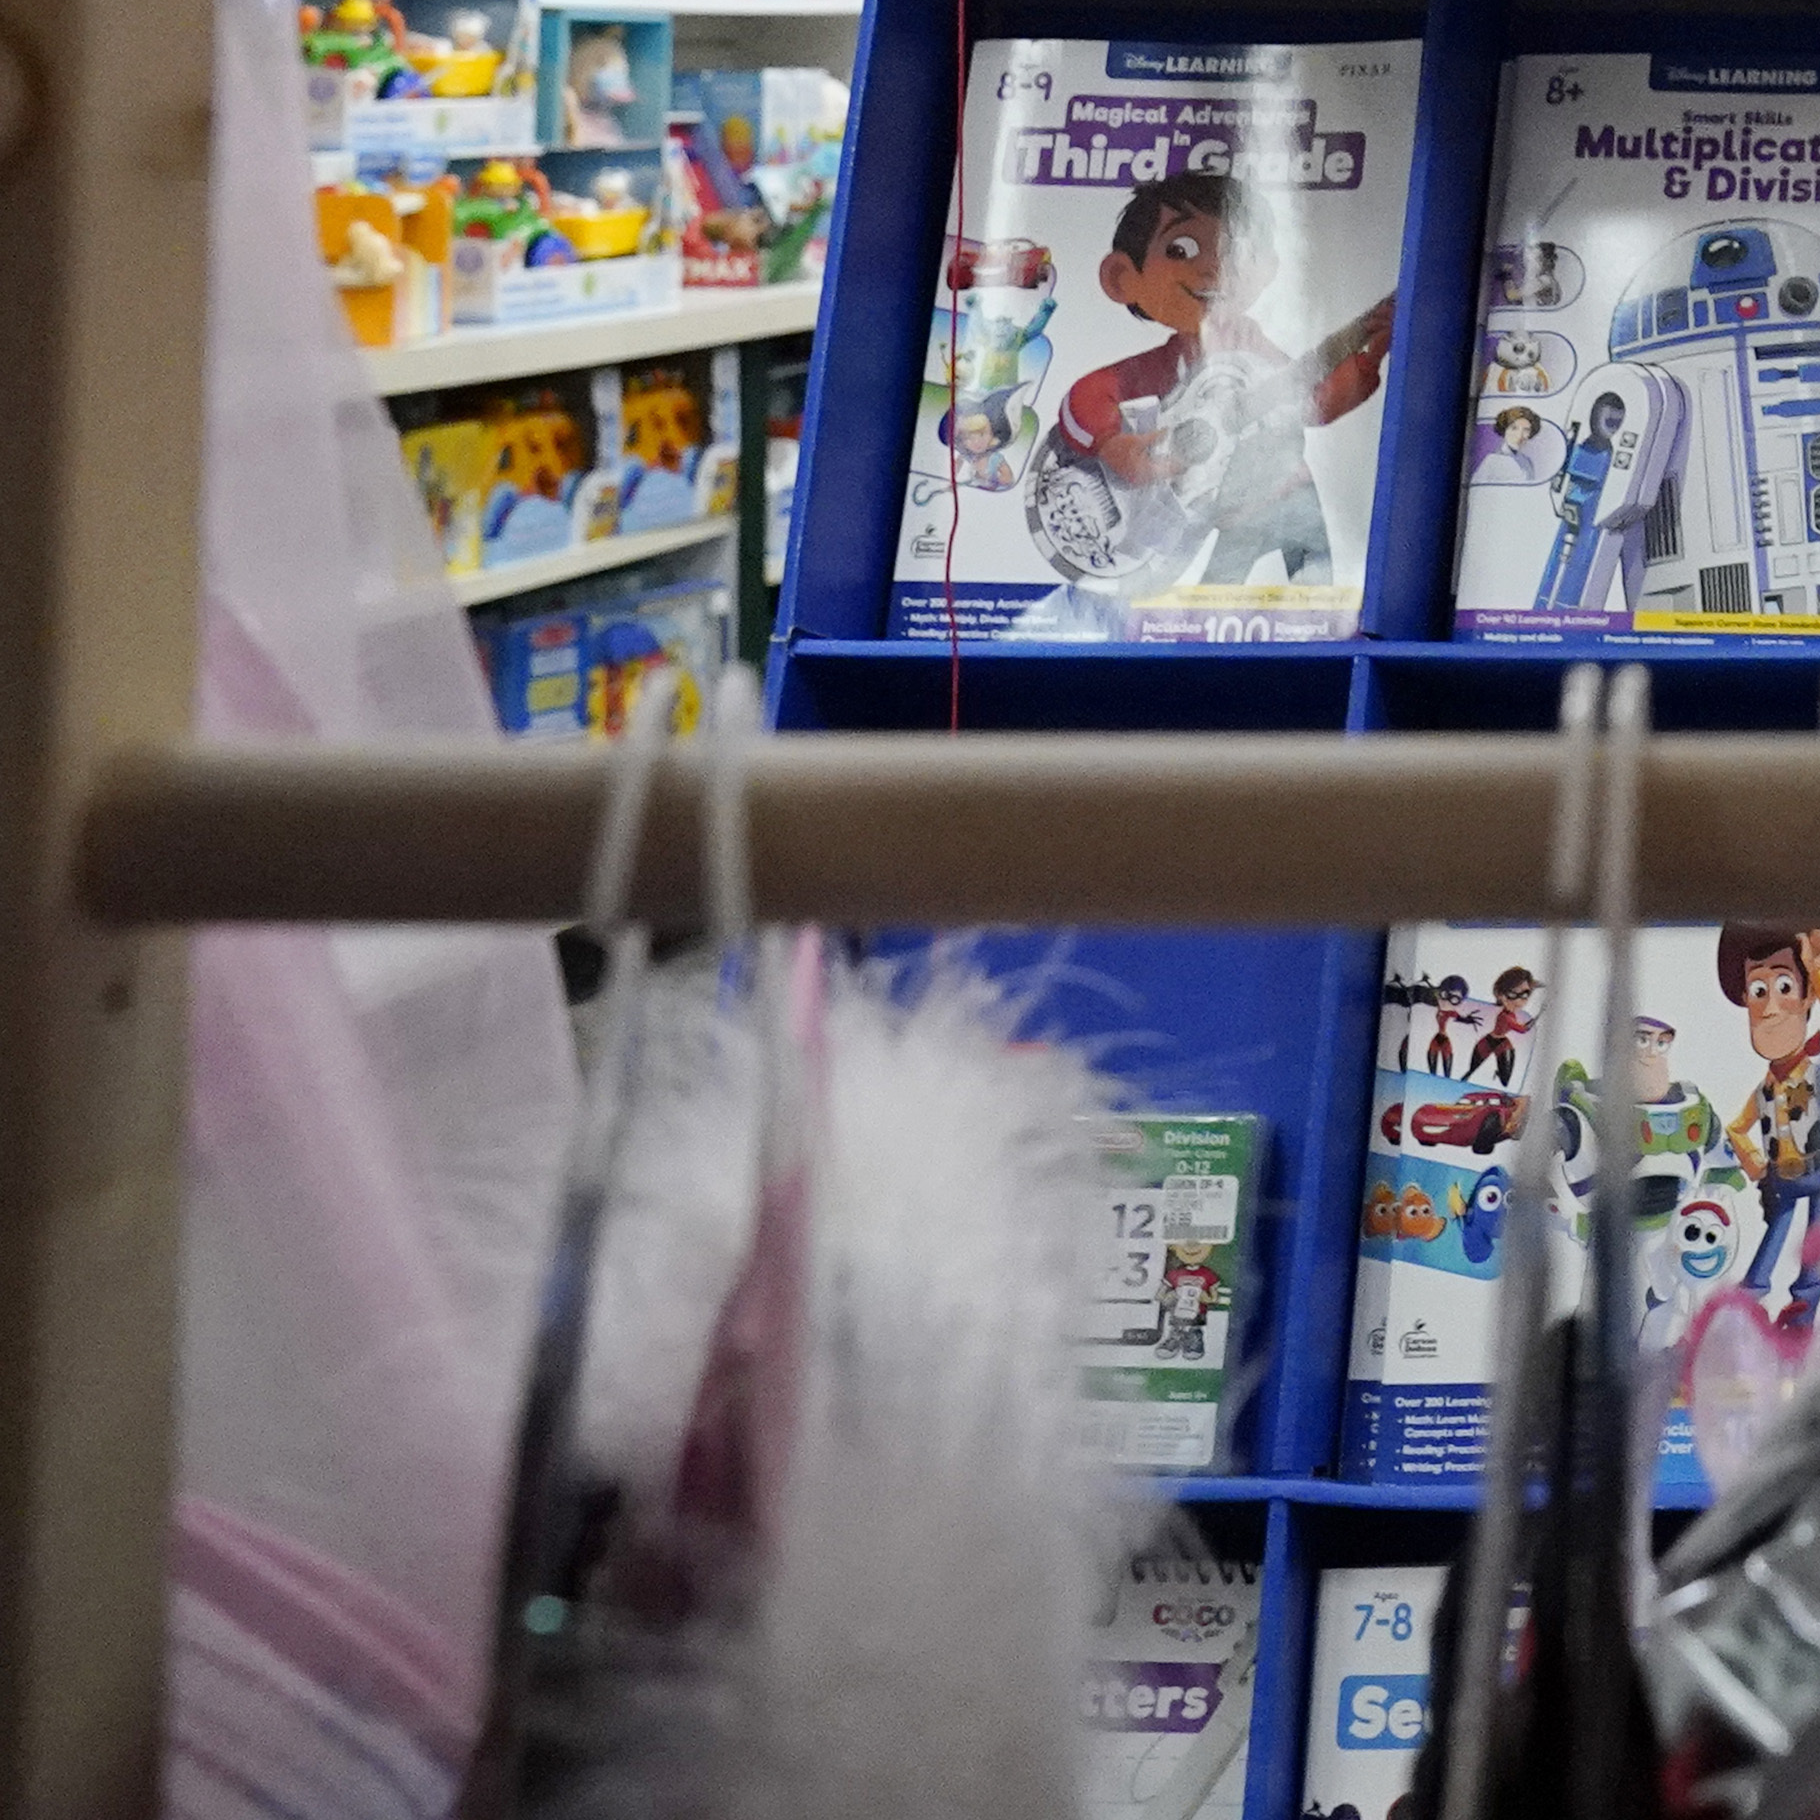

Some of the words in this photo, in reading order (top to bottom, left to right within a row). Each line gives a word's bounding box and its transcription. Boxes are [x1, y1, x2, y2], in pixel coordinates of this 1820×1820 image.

[1545, 75, 1585, 105] 8+
[1708, 68, 1817, 86] LEARNING
[1071, 101, 1168, 128] Magical
[1681, 109, 1737, 126] Smart
[1015, 133, 1171, 182] Third
[1662, 165, 1692, 202] &
[1163, 1131, 1231, 1146] Division
[1111, 1203, 1156, 1239] 12
[1152, 1602, 1236, 1628] COCO
[1353, 1602, 1413, 1643] 7-8
[1348, 1683, 1424, 1740] Se
